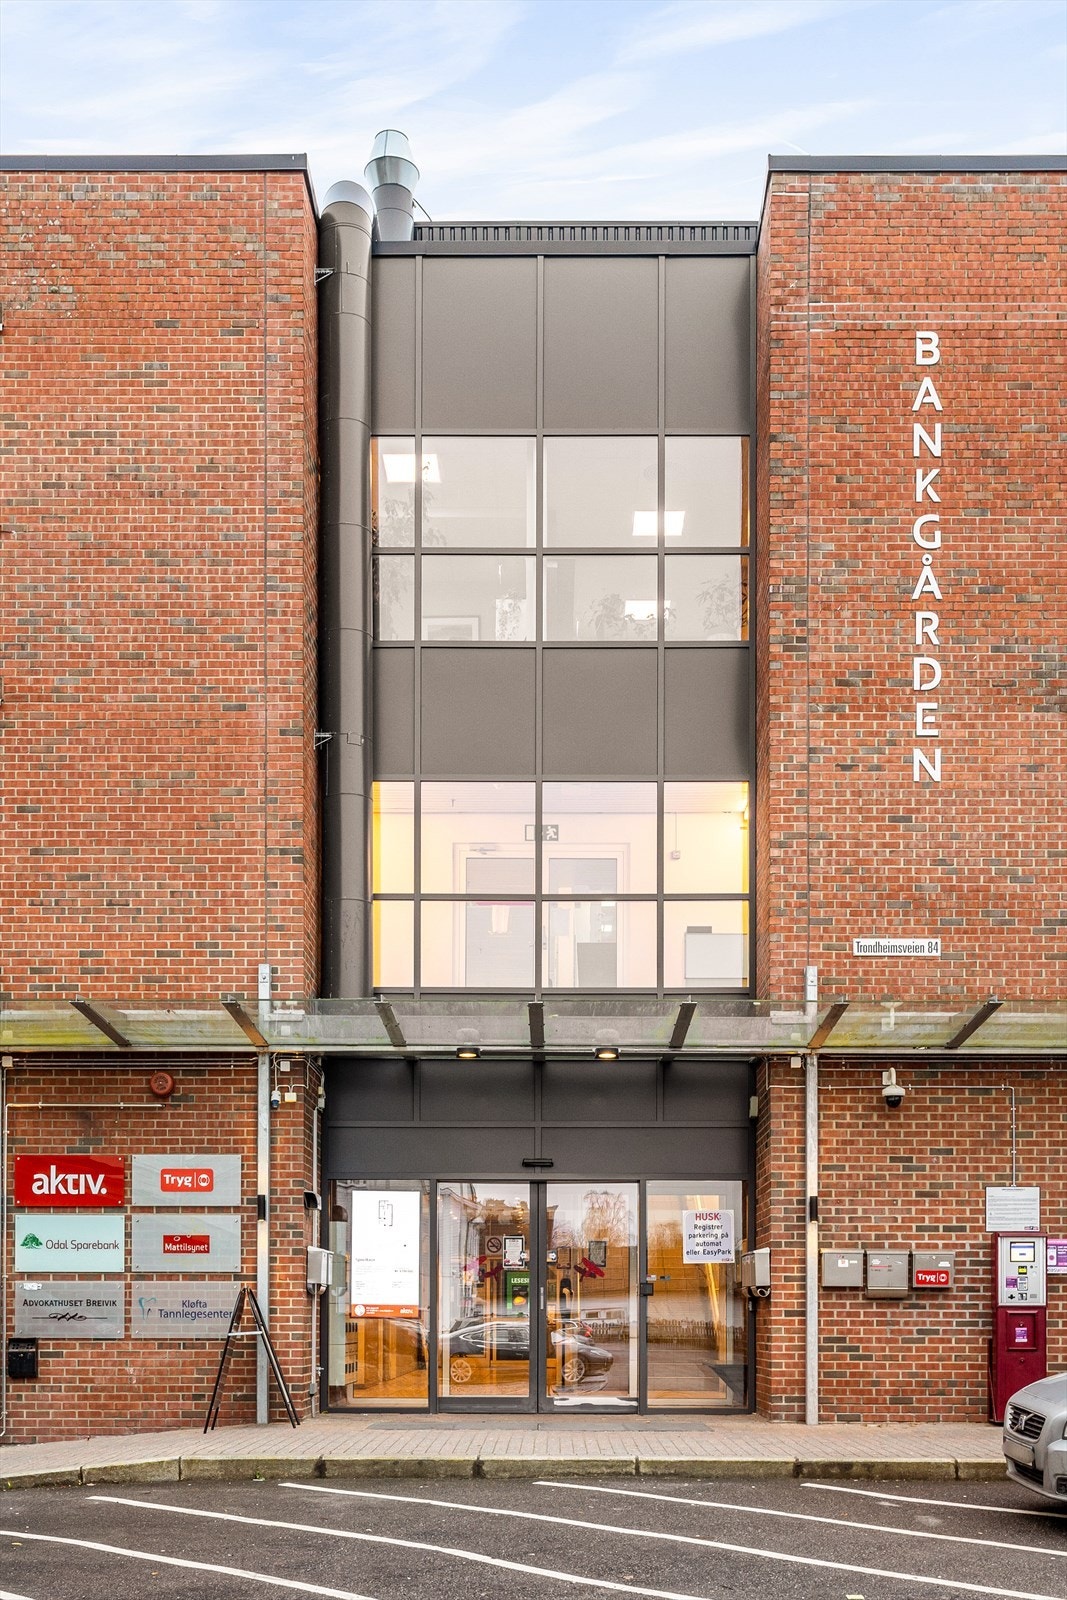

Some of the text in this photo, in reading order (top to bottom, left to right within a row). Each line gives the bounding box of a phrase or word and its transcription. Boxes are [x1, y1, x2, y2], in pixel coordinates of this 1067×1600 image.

[912, 330, 943, 783] BANKGÅRDEN
[855, 941, 939, 954] Trondheimsveien 84
[164, 1174, 192, 1188] Tryg
[695, 1212, 722, 1221] HUSK:
[688, 1232, 718, 1240] parkering
[46, 1239, 120, 1251] Odal Sparebank
[164, 1242, 208, 1252] Mattilsynet
[917, 1273, 936, 1282] Tryg
[182, 1300, 207, 1308] Kløfta
[158, 1308, 232, 1320] Tannlegesenter
